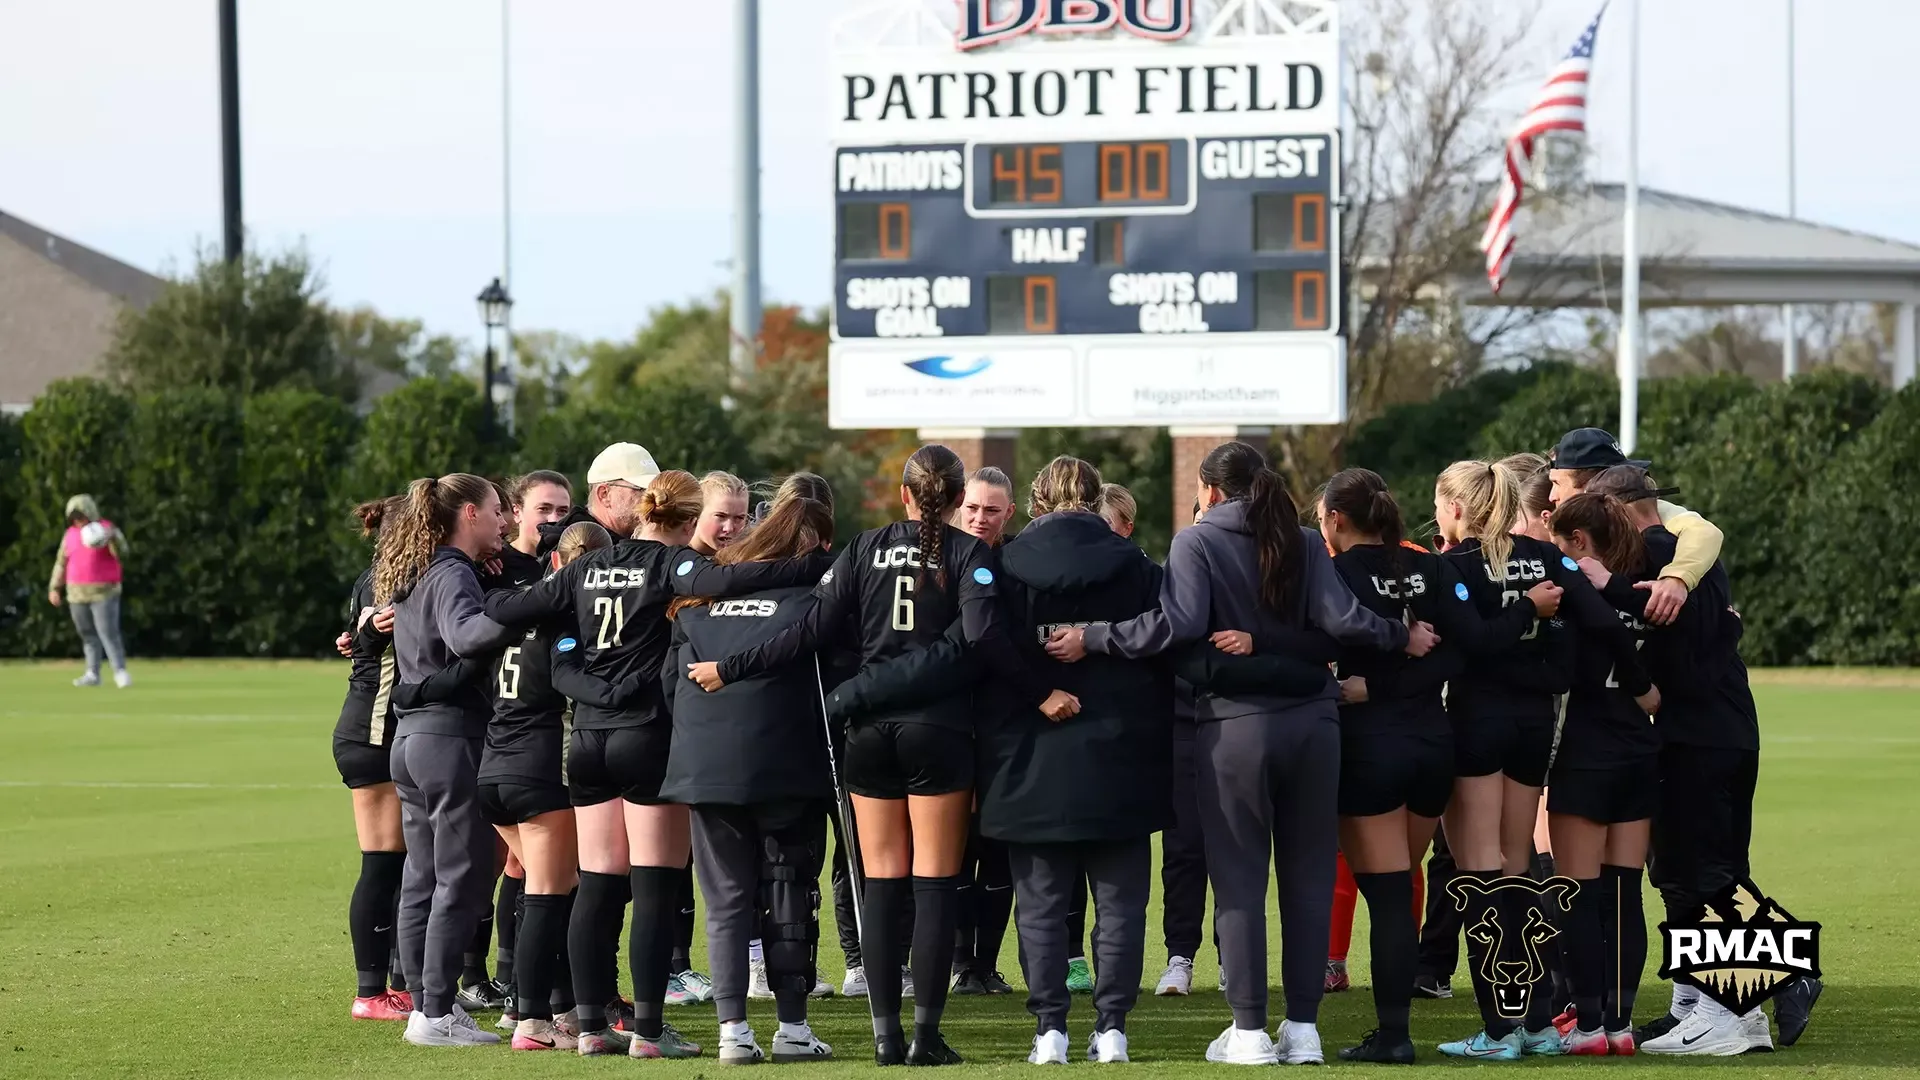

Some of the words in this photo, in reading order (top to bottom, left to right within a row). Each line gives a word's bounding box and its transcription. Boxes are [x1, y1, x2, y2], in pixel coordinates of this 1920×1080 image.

[843, 69, 1113, 121] PATRIOT
[1135, 63, 1323, 114] FIELD
[838, 150, 963, 191] PATRIOTS
[994, 146, 1062, 204] 45
[1200, 138, 1325, 179] GUEST
[879, 203, 910, 260] 0
[1294, 193, 1325, 251] 0
[1012, 227, 1087, 263] HALF
[847, 276, 930, 309] SHOTS
[932, 275, 971, 308] ON
[1025, 276, 1056, 333] 0
[1109, 272, 1195, 305] SHOTS
[1198, 271, 1238, 304] ON
[1294, 271, 1325, 328] 0
[875, 306, 943, 337] GOAL
[1139, 301, 1209, 333] GOAL
[583, 567, 645, 590] UCCS
[594, 596, 625, 650] 21
[709, 599, 778, 617] UCCS
[892, 575, 914, 632] 6
